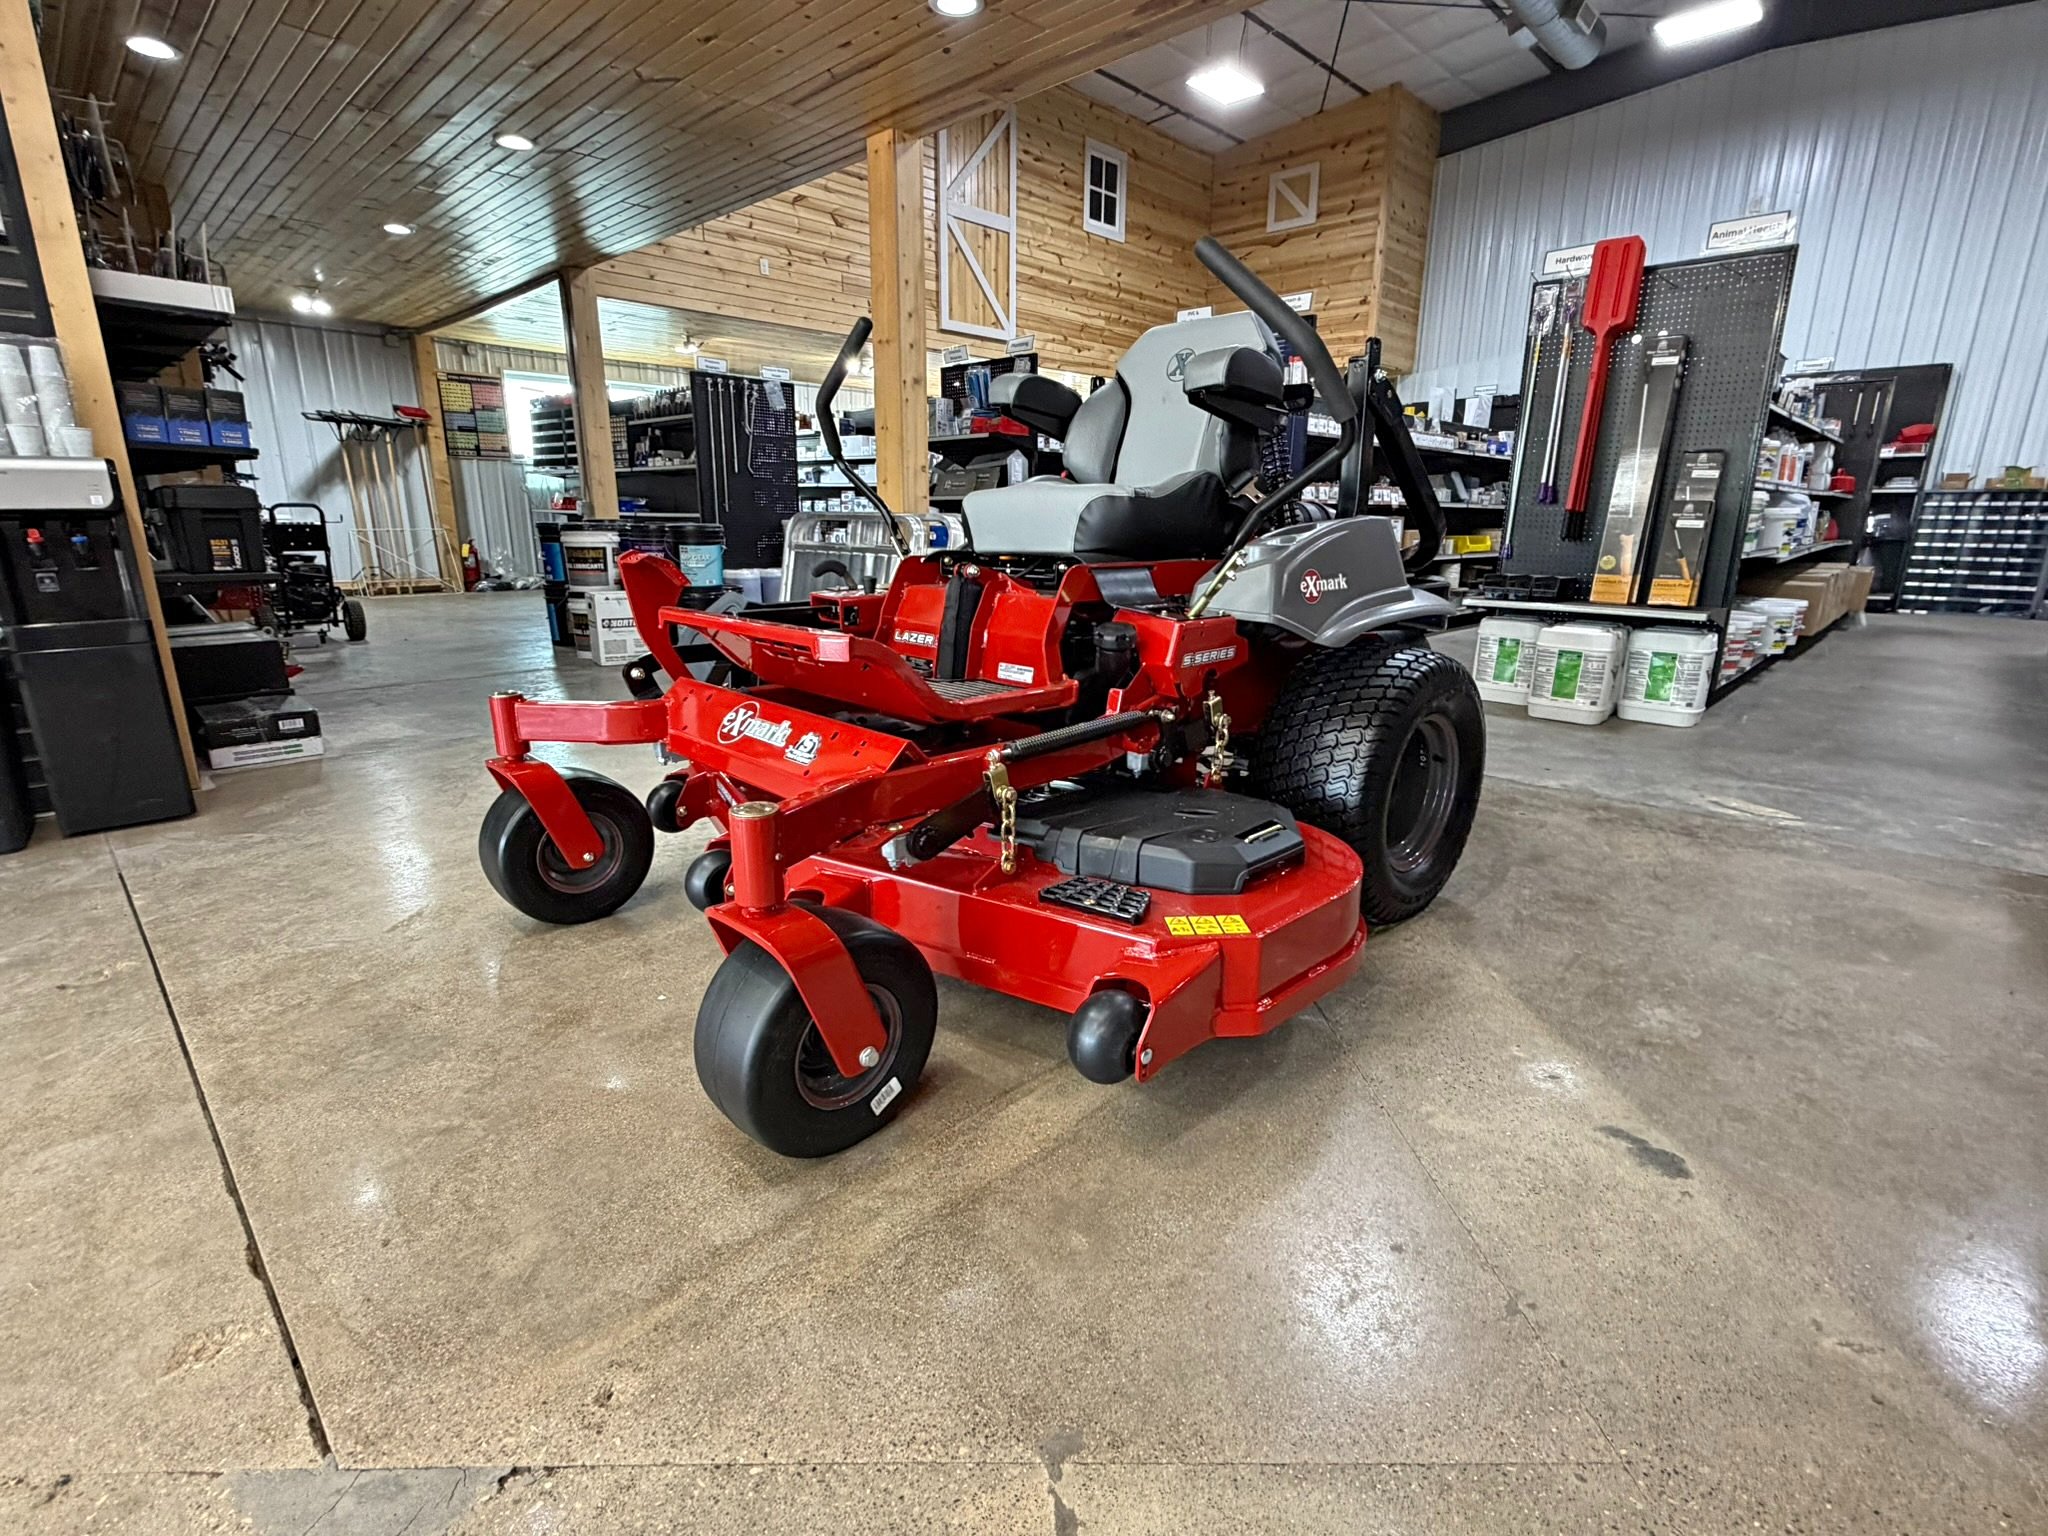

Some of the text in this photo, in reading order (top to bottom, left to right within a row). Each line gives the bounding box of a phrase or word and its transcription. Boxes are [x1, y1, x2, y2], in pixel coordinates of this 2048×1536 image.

[1712, 227, 1747, 240] Animal
[1300, 572, 1348, 598] eXmark
[894, 631, 934, 645] LAZER
[721, 707, 793, 748] eXmark
